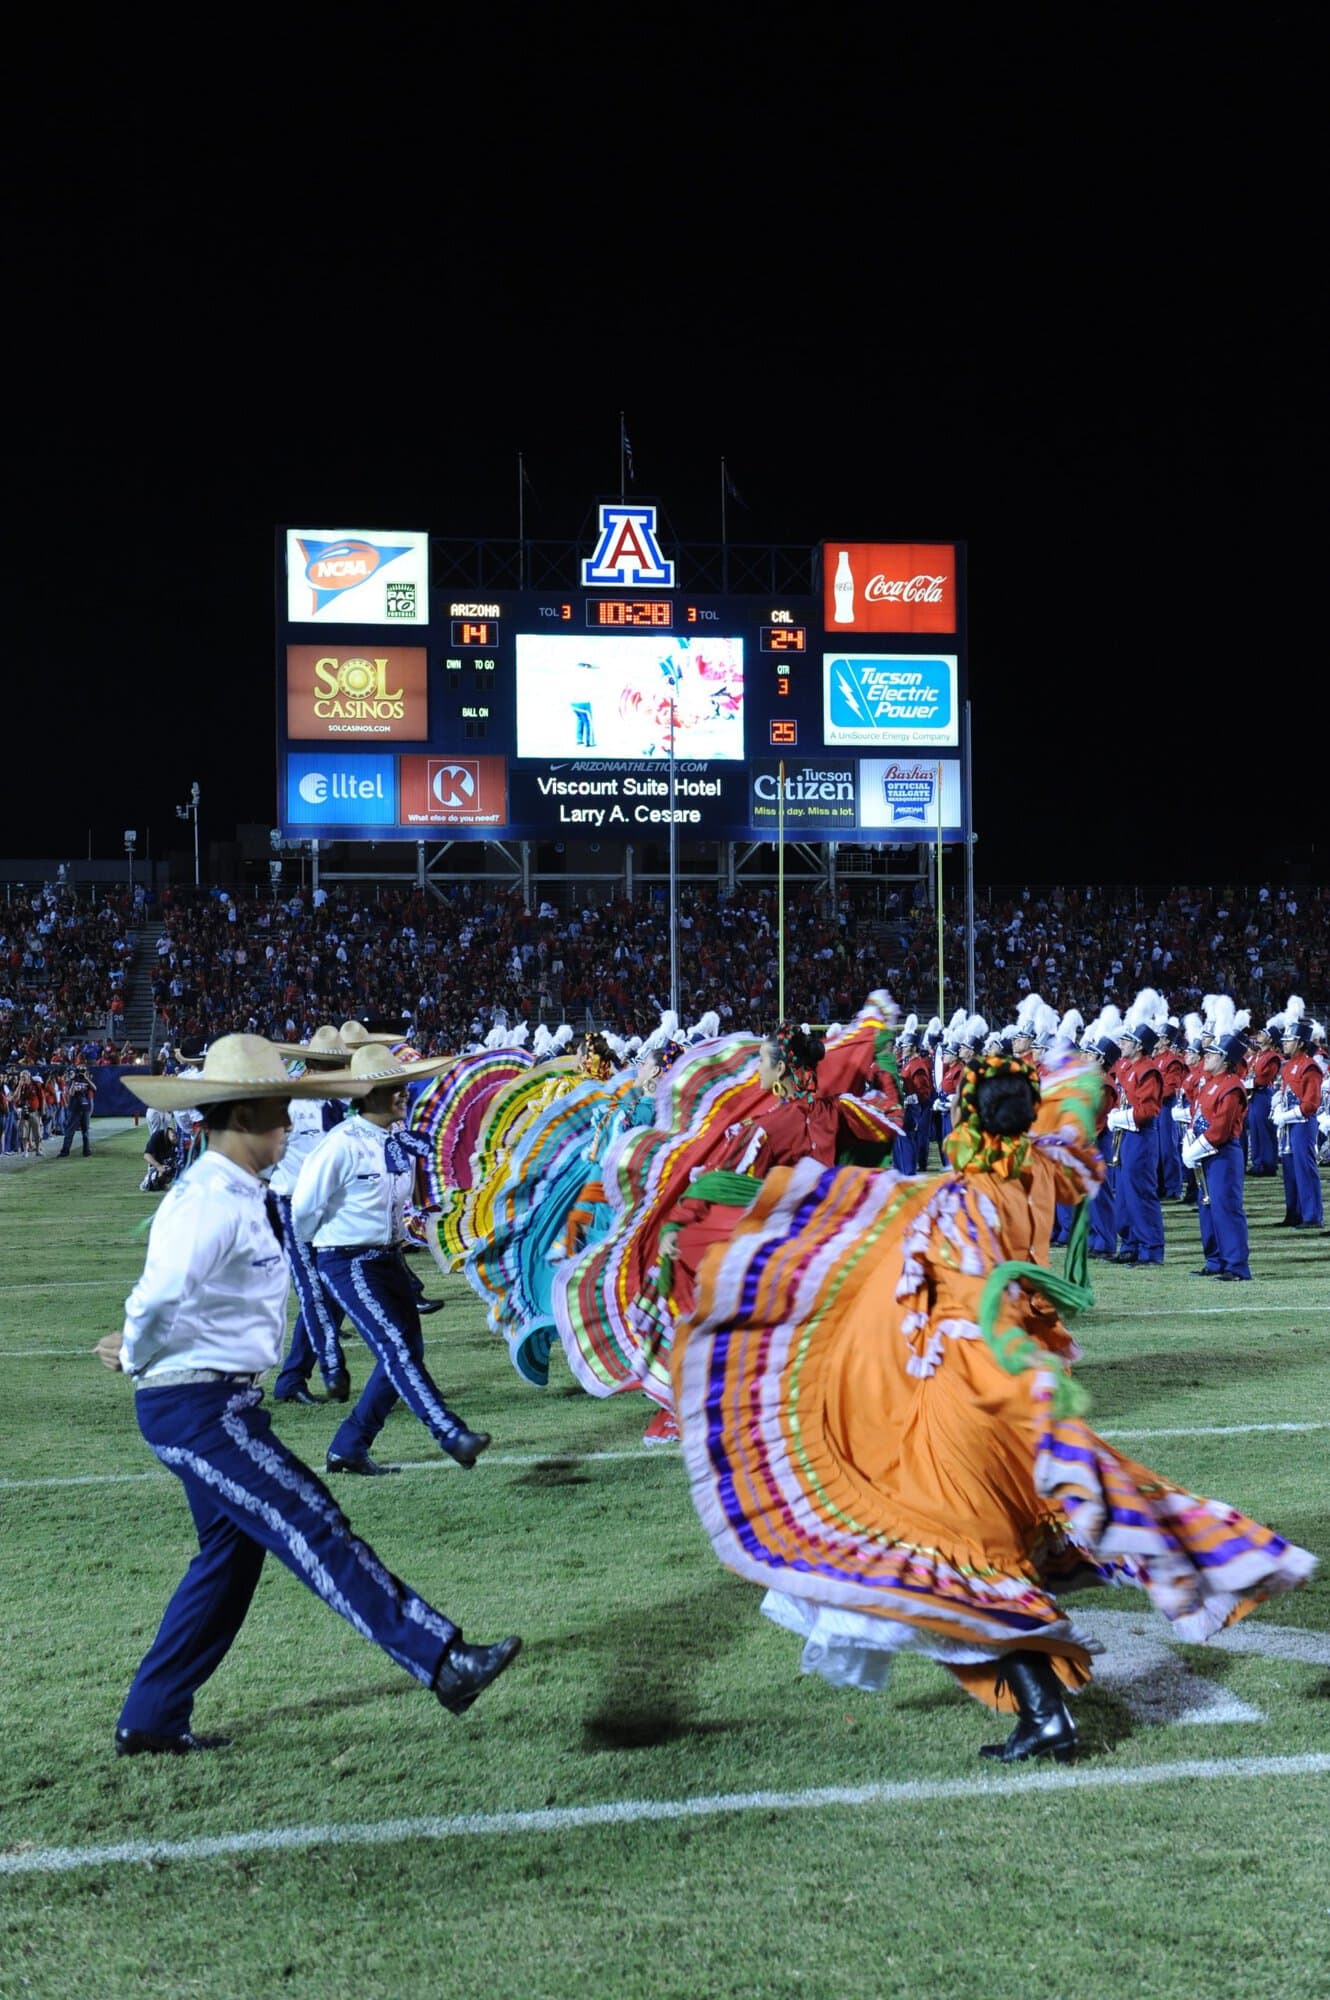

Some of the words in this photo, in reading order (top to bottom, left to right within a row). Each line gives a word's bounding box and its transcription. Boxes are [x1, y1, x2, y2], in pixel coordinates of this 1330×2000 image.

[581, 504, 675, 588] A
[317, 560, 368, 578] NCAA
[387, 591, 415, 601] PAC
[388, 600, 415, 611] 10
[450, 603, 500, 617] ARIZONA
[539, 607, 559, 617] TOL
[561, 605, 571, 620] 3
[599, 602, 670, 625] 10:28
[687, 607, 697, 622] 3
[700, 610, 720, 620] TOL
[771, 610, 794, 624] CAL
[463, 624, 487, 644] 14
[771, 630, 803, 650] 24
[474, 660, 484, 670] TO
[484, 660, 495, 670] GO
[313, 657, 404, 700] SOL
[860, 667, 922, 685] Tucson
[778, 678, 789, 695] 3
[866, 686, 939, 702] Electric
[313, 700, 405, 720] CASINOS
[462, 708, 478, 718] BALL
[479, 708, 489, 718] ON
[874, 702, 939, 719] Power
[328, 724, 391, 733] SOLCASINOS.COM
[772, 722, 795, 743] 25
[882, 732, 910, 741] Energy
[912, 732, 950, 741] Company
[802, 768, 852, 781] Tucson
[537, 777, 618, 796] Viscount
[623, 778, 669, 796] Suite
[674, 779, 721, 797] Hotel
[754, 775, 855, 800] Citizen
[408, 814, 429, 822] What
[448, 814, 459, 822] do
[460, 815, 474, 823] you
[475, 814, 500, 822] need?
[560, 805, 605, 827] Larry
[609, 805, 630, 823] A.
[634, 806, 701, 823] Cesare
[754, 806, 776, 815] Miss
[786, 807, 805, 816] day.
[808, 807, 830, 815] Miss
[839, 807, 854, 815] lot.
